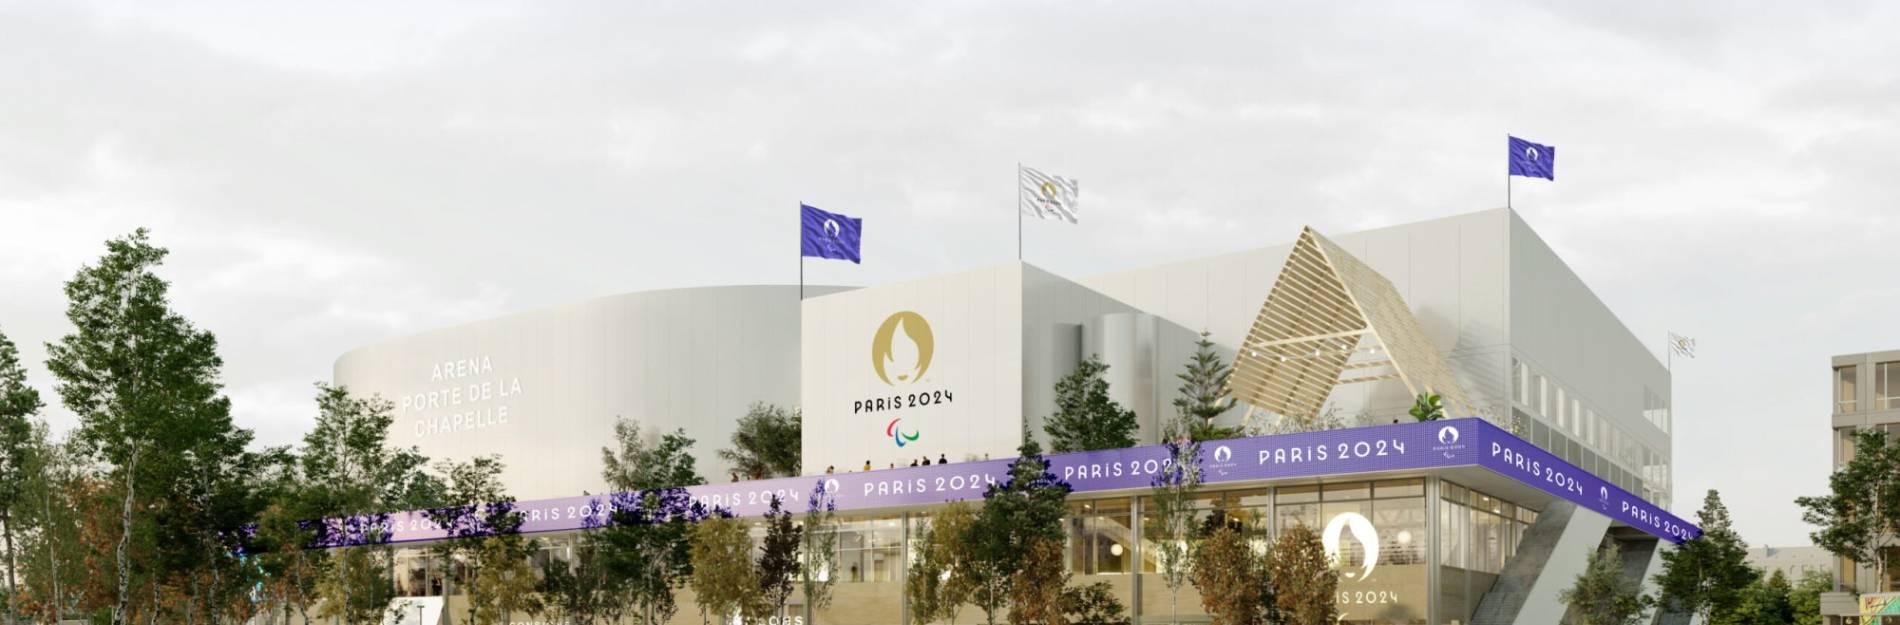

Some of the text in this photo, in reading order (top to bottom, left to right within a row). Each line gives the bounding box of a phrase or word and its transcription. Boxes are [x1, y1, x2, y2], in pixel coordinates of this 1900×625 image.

[432, 356, 493, 382] ARENA
[402, 377, 522, 413] PORTE DE LA
[908, 389, 952, 408] 2024
[416, 405, 508, 438] CHAPELLE
[1338, 439, 1405, 459] 2024
[1130, 458, 1172, 475] 202
[935, 473, 996, 491] 2024
[1545, 467, 1583, 496] 2024
[1355, 591, 1398, 604] 2024
